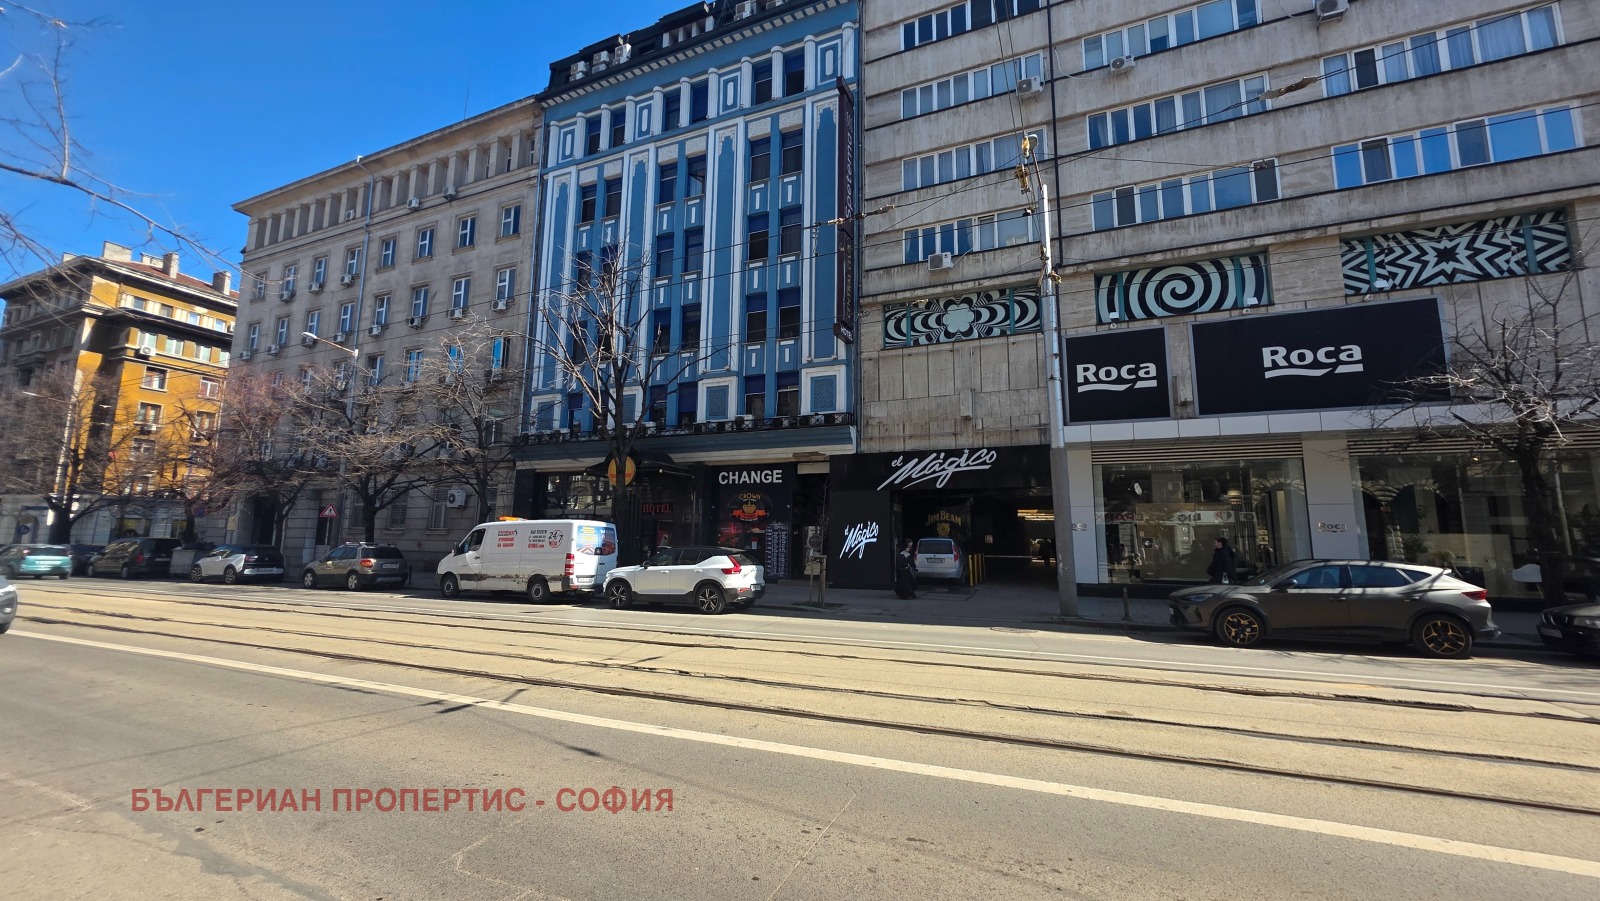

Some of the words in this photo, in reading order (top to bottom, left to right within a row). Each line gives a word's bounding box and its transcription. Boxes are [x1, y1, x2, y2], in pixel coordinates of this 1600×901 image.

[840, 326, 853, 341] HOTEL
[1262, 344, 1362, 368] Roca
[1076, 362, 1157, 383] Roca
[877, 447, 997, 491] Mágico
[891, 455, 904, 467] el
[718, 469, 783, 485] CHANGE
[642, 503, 671, 513] HOTEL
[925, 513, 940, 526] JIM
[940, 510, 962, 527] BEAM
[1318, 522, 1348, 531] Roca
[839, 521, 879, 560] Mágico
